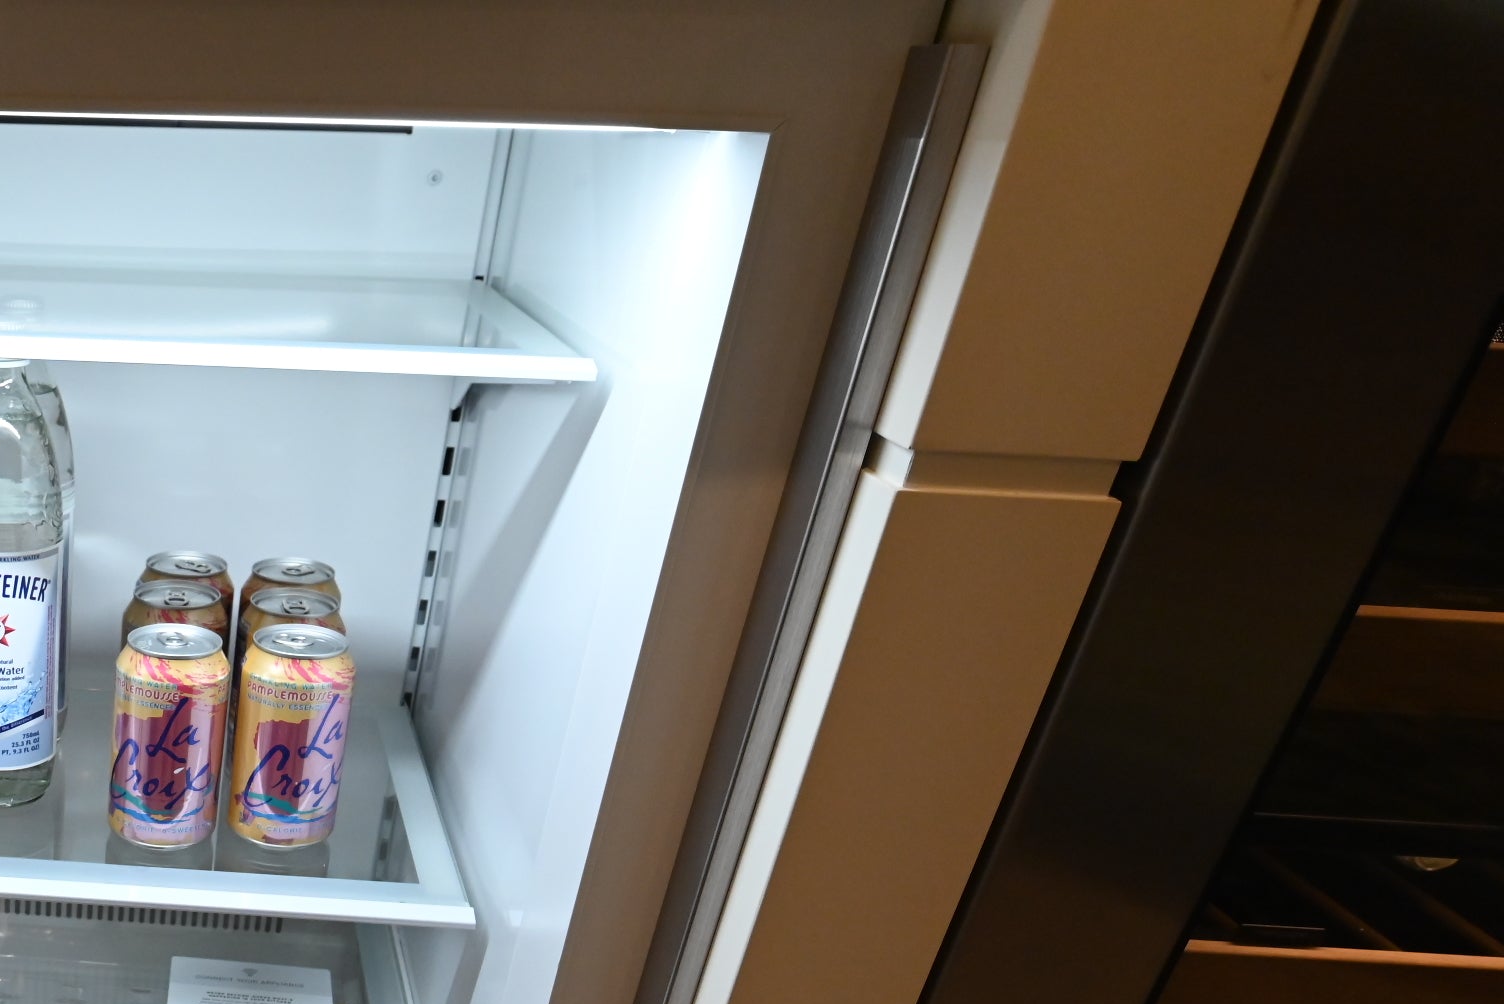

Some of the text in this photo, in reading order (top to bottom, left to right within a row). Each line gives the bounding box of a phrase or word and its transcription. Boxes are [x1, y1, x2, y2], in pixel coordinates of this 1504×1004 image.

[23, 553, 41, 561] WATER
[146, 680, 179, 691] WATER
[247, 680, 333, 701] PAMPLEMOUSSE
[146, 697, 200, 763] La
[298, 694, 343, 759] La
[110, 739, 211, 810] Croix
[244, 744, 342, 808] Croix
